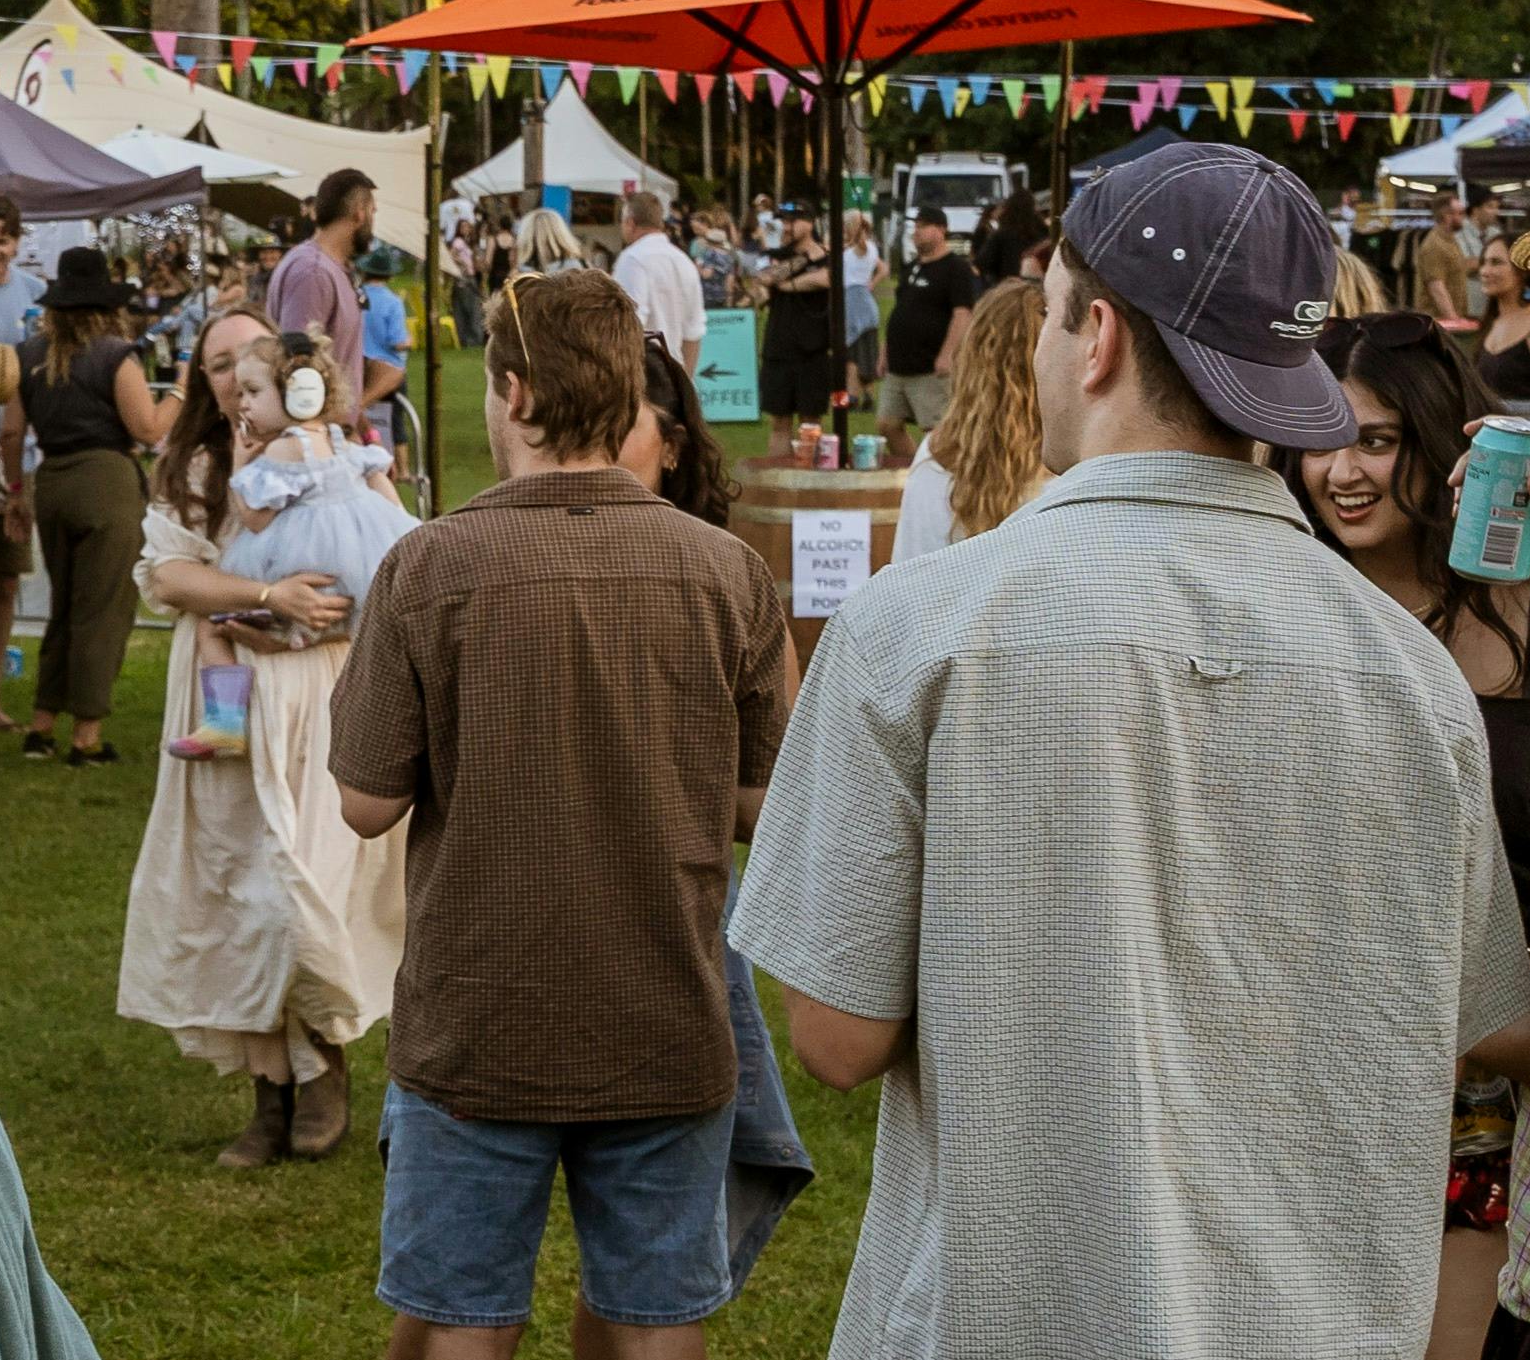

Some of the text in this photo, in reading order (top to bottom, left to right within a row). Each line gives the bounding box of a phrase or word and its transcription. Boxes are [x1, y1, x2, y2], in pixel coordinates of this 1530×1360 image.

[699, 387, 754, 407] OFFEE
[820, 520, 842, 532] NO
[799, 539, 866, 552] ALCOHOL
[811, 558, 849, 570] PAST
[815, 577, 847, 590] THIS
